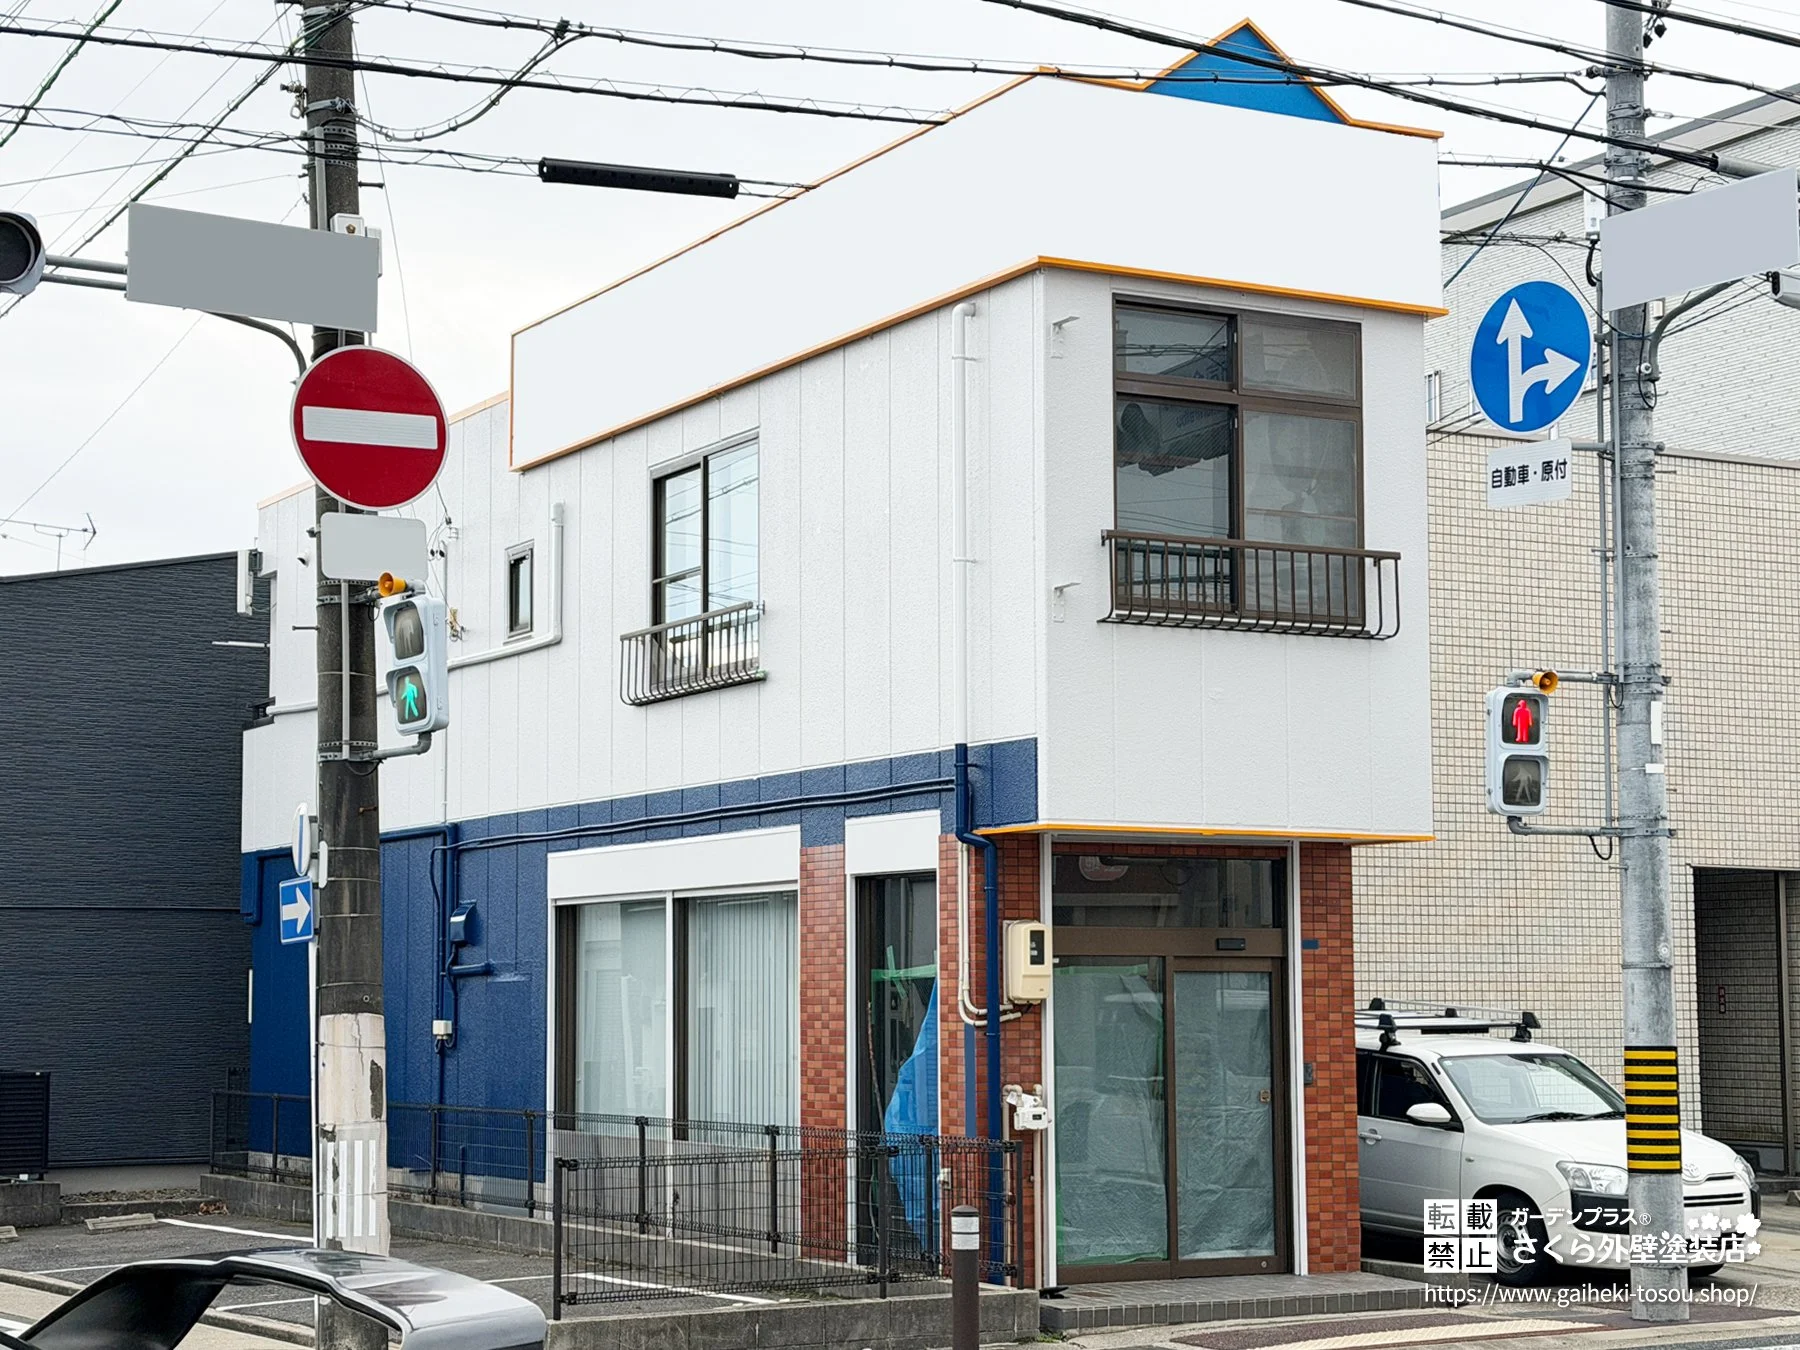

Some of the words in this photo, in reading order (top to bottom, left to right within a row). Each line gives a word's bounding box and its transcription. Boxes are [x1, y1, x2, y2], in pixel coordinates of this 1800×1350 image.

[1491, 458, 1568, 489] 自動車・原付
